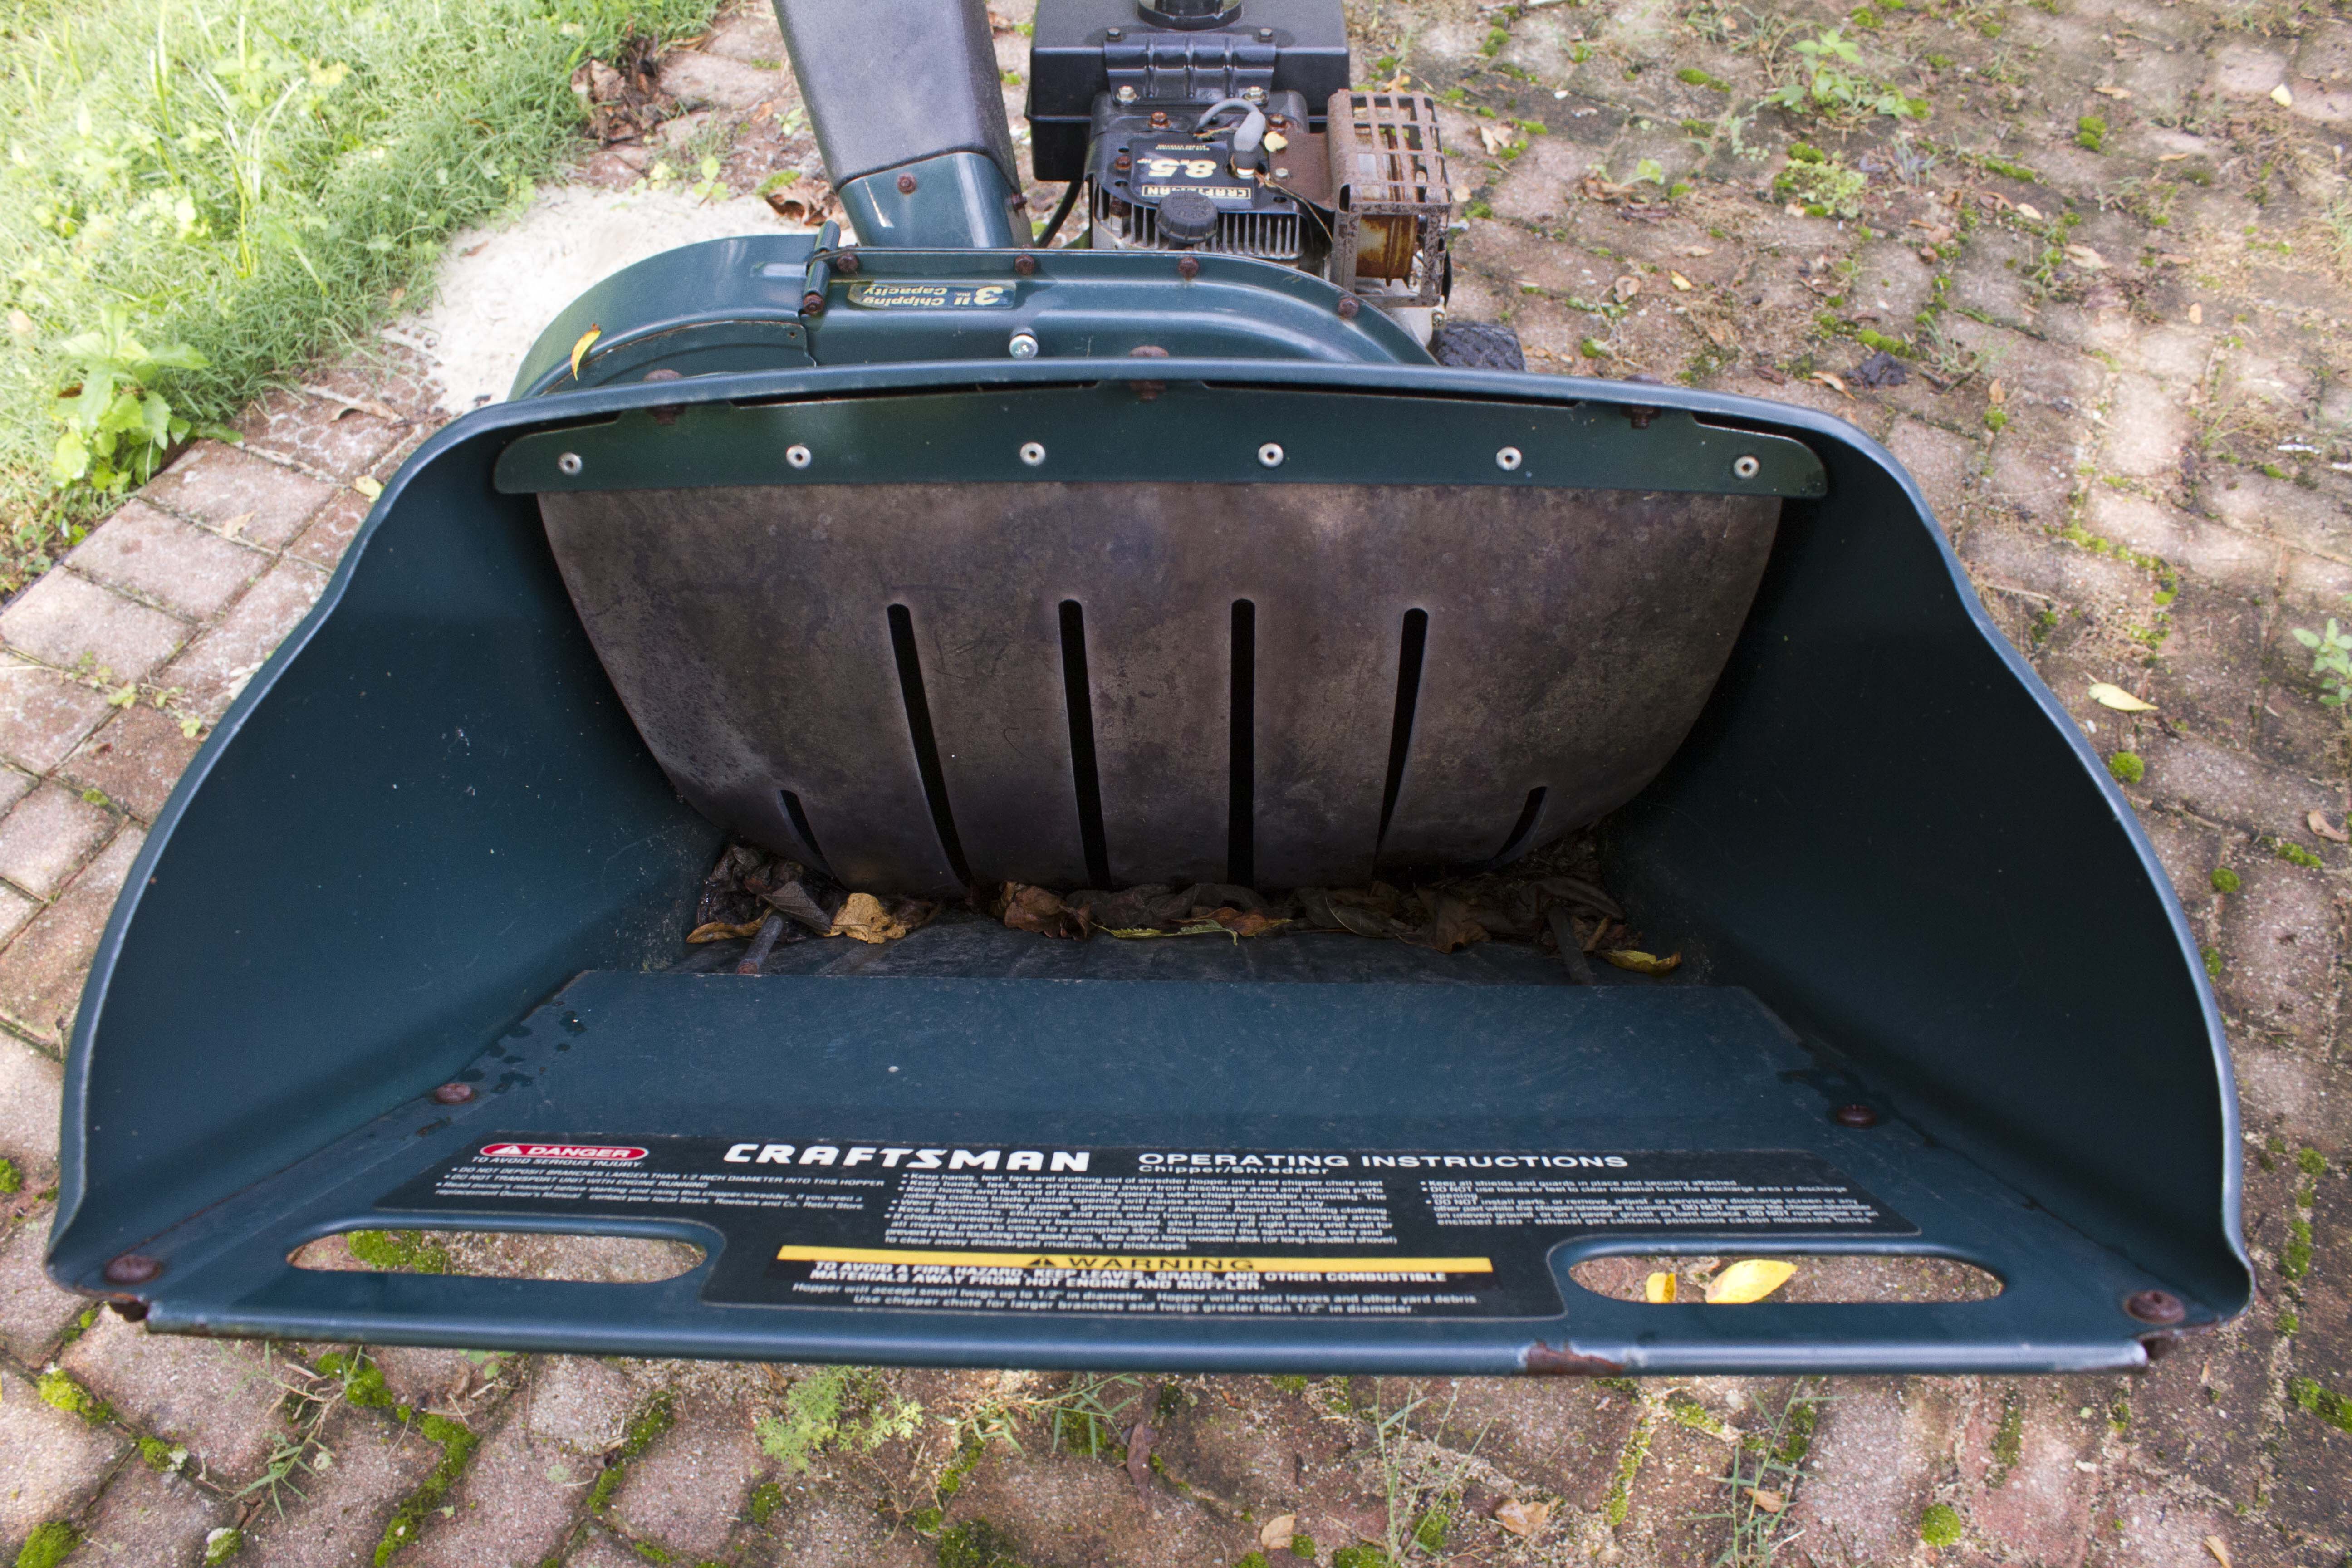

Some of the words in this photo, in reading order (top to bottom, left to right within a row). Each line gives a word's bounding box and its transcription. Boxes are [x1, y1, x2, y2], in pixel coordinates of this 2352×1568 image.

[1148, 158, 1217, 178] 8.5
[862, 286, 947, 296] Capacity
[862, 296, 945, 306] Chipping
[526, 1147, 631, 1158] DANGER
[723, 1144, 1090, 1171] CRAFTSMAN
[1138, 1154, 1350, 1166] OPERATING
[1362, 1156, 1629, 1167] INSTRUCTIONS
[1138, 1165, 1329, 1174] Chipper/Shredder
[815, 1261, 838, 1270] TO
[839, 1262, 893, 1273] AVOID
[896, 1264, 909, 1273] A
[911, 1265, 950, 1274] FIRE
[954, 1267, 1027, 1277] HAZARD,
[1034, 1269, 1077, 1278] KEEP
[1080, 1270, 1149, 1279] LEAVES,
[1154, 1271, 1218, 1280] GRASS,
[1223, 1272, 1261, 1281] AND
[1264, 1273, 1322, 1281] OTHER
[1325, 1273, 1446, 1281] COMBUSTIBLE
[1069, 1259, 1254, 1271] WARNING
[809, 1270, 909, 1282] MATERIALS
[912, 1274, 964, 1284] AWAY
[969, 1276, 1021, 1285] FROM
[1025, 1278, 1059, 1286] HOT
[1066, 1279, 1129, 1288] ENGINE
[1134, 1280, 1172, 1289] AND
[1176, 1281, 1264, 1290] MUFFLER.
